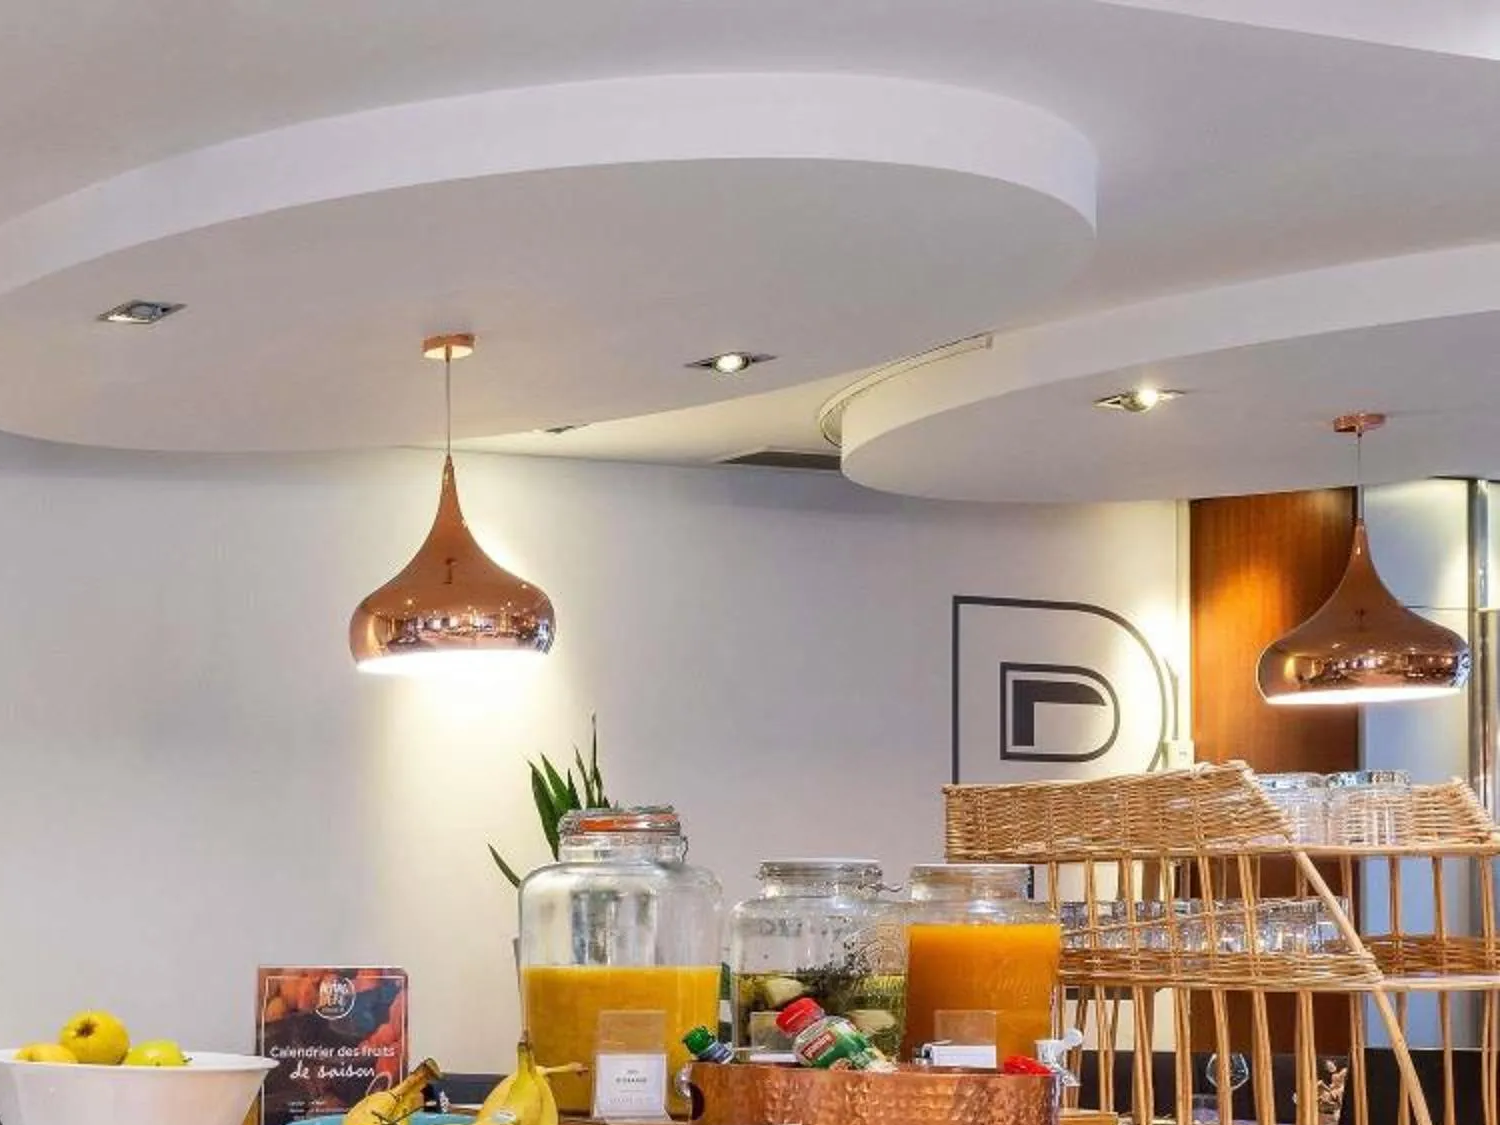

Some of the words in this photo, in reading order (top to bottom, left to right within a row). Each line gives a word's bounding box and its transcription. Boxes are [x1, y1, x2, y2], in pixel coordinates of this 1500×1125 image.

[269, 1045, 336, 1059] Calendrier
[337, 1045, 358, 1058] des
[359, 1045, 395, 1058] fruits
[289, 1060, 310, 1080] de
[317, 1062, 375, 1079] saison
